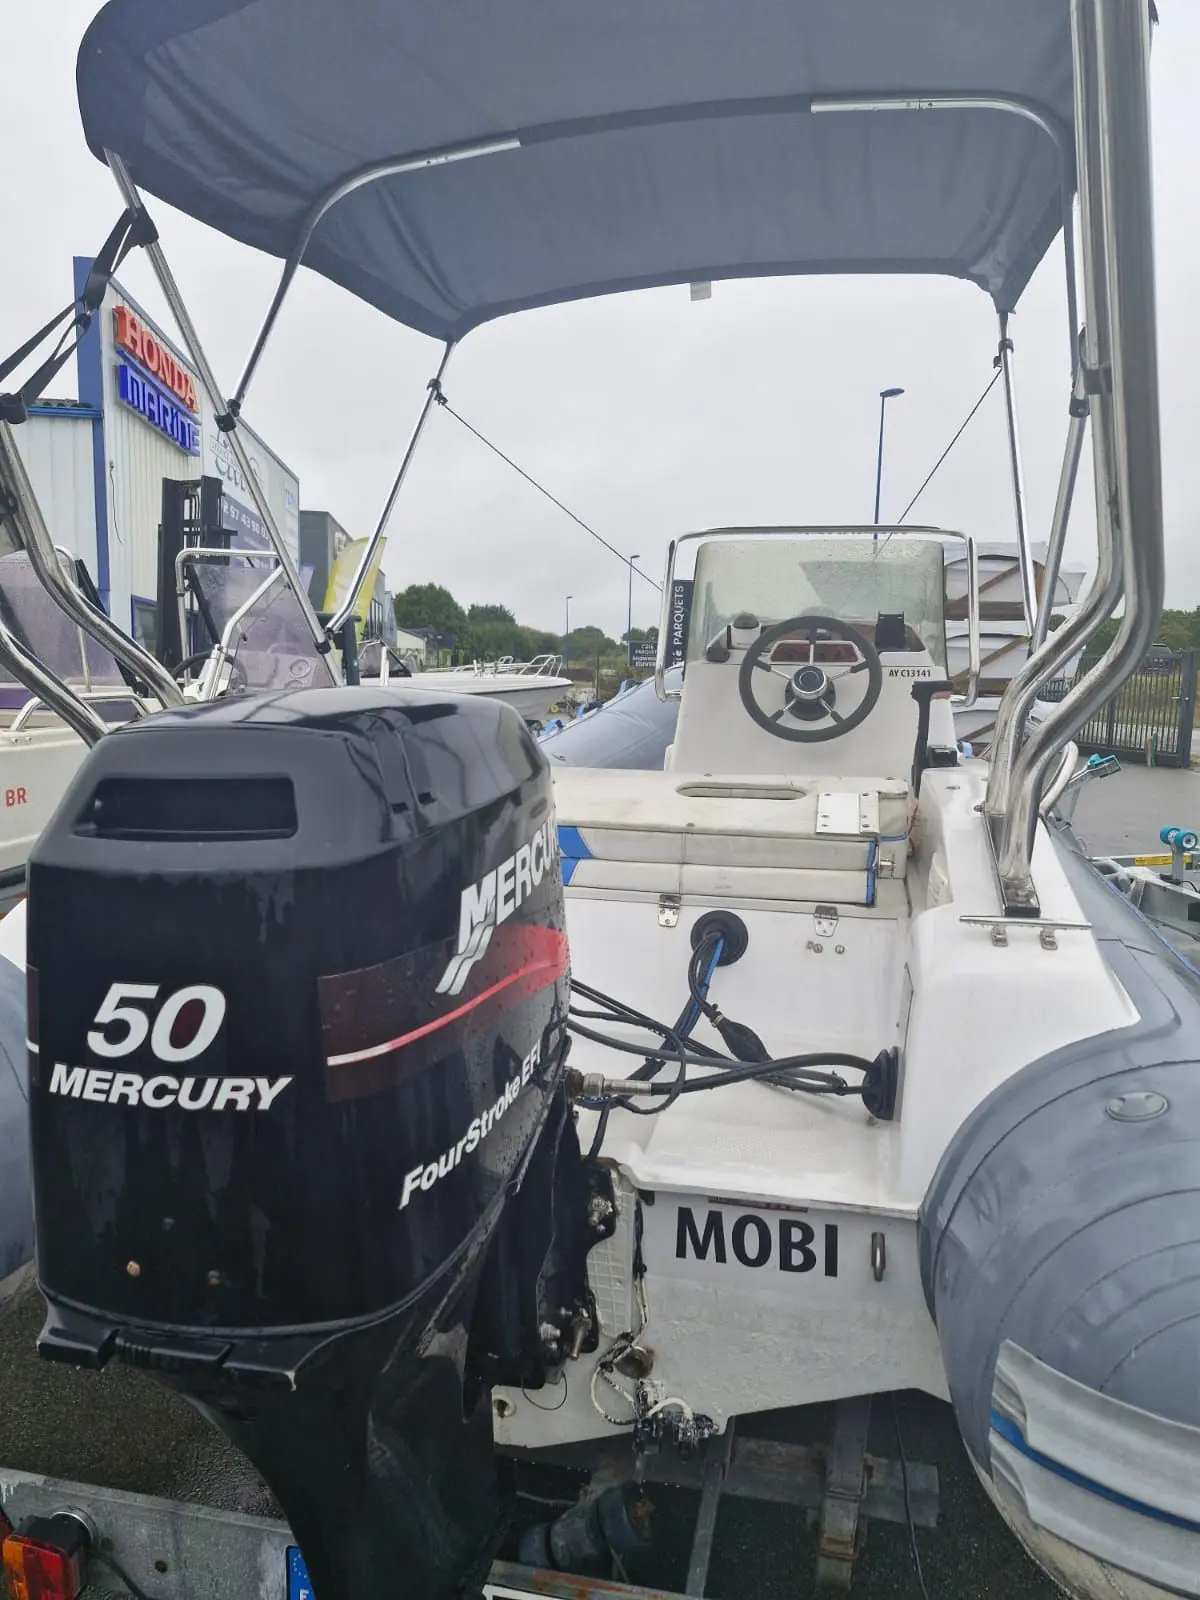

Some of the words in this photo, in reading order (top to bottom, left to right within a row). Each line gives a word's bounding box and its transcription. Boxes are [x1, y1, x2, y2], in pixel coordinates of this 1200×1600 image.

[114, 306, 198, 414] HONDA
[117, 364, 200, 457] MARINE
[673, 585, 685, 645] PARQUETS
[889, 669, 899, 677] AY
[5, 787, 28, 807] BR
[435, 808, 558, 997] MERCUR
[87, 982, 226, 1063] 50
[48, 1062, 294, 1112] MERCURY
[398, 1076, 522, 1211] FourStroke
[520, 1039, 542, 1087] EFI
[675, 1206, 838, 1278] MOBI
